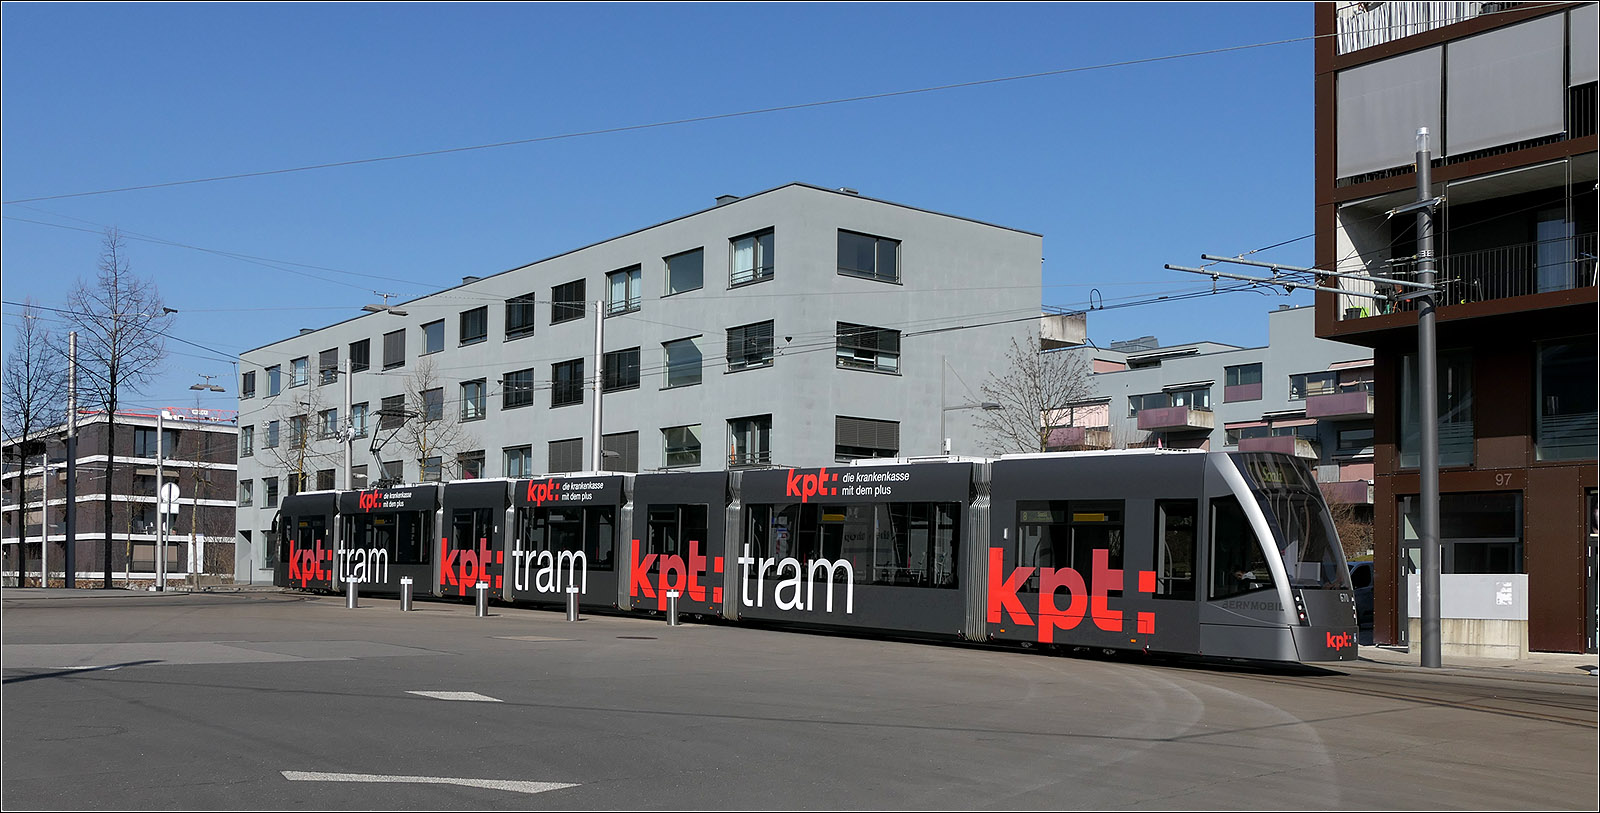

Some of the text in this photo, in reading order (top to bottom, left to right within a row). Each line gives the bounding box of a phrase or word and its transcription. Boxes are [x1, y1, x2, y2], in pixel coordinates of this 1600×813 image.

[527, 478, 561, 507] kpt:
[562, 481, 604, 490] die krankenkasse
[787, 467, 838, 503] kpt:
[842, 485, 892, 497] mit dem plus
[843, 471, 910, 483] die krankenkasse
[1495, 473, 1512, 486] 97
[359, 490, 383, 513] kpt:
[570, 492, 581, 500] dem
[581, 492, 593, 502] plus
[288, 540, 333, 588] kpt:
[338, 539, 389, 584] tram
[440, 538, 503, 597] kpt:
[511, 538, 588, 595] tram
[630, 540, 724, 611] kpt:
[737, 543, 854, 615] tram
[987, 547, 1157, 643] kpt:
[1327, 632, 1352, 651] kpt:
